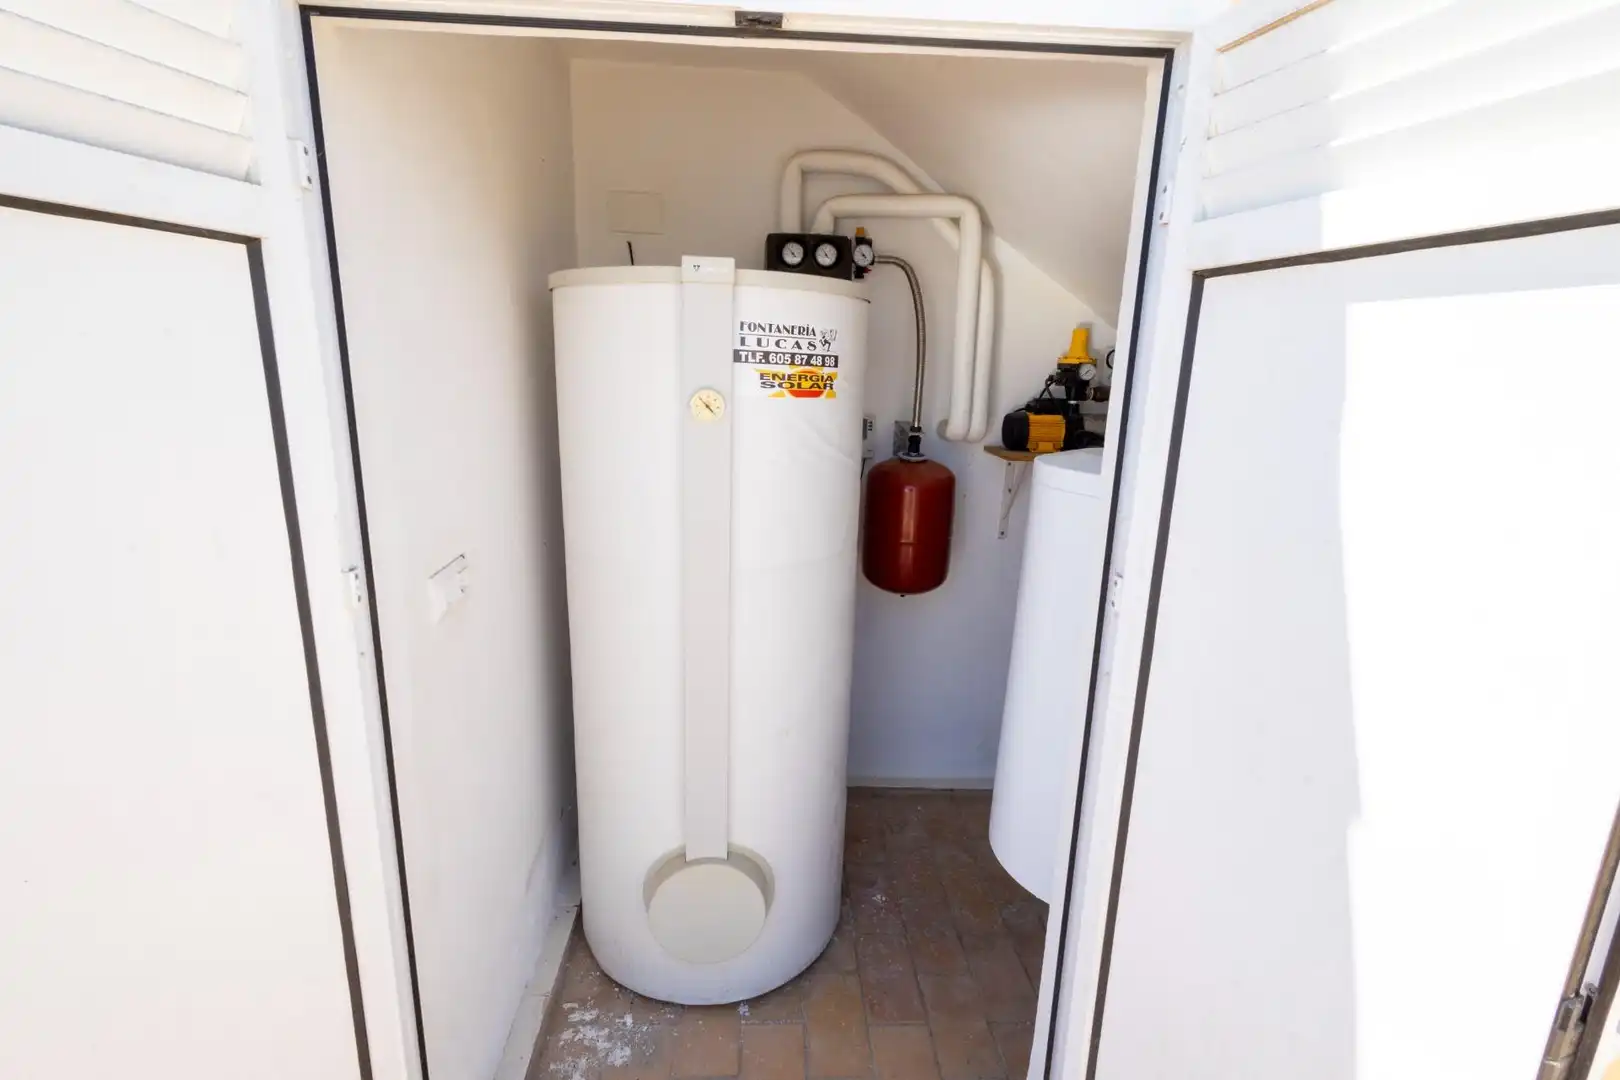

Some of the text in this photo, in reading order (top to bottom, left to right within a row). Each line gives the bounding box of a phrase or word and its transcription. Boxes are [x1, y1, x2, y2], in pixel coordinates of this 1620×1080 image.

[740, 337, 817, 351] LUCAS
[739, 351, 835, 367] TLF. 605 87 48 98
[760, 380, 834, 390] SOLAR
